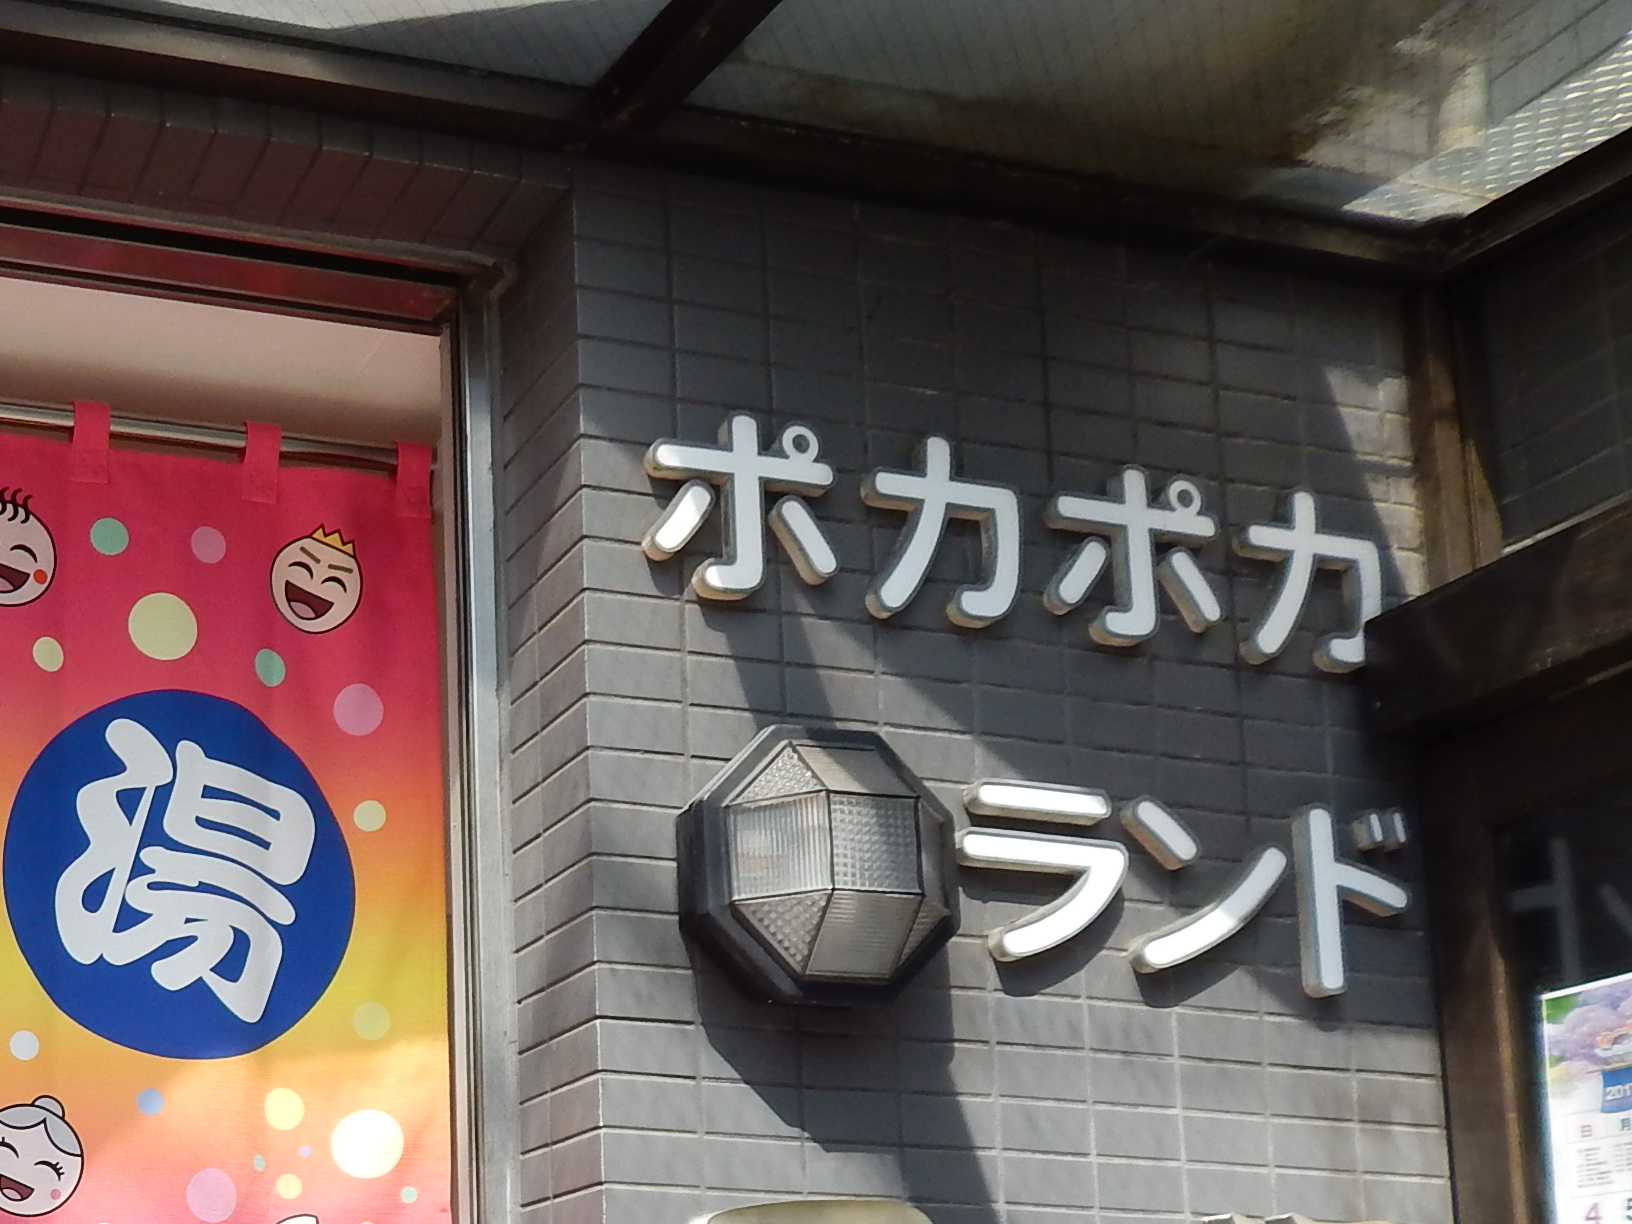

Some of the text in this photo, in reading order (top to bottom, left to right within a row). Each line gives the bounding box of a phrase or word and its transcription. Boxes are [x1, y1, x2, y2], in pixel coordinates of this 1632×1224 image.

[642, 412, 1382, 672] ポカポカ
[956, 779, 1408, 998] ランド
[1605, 1083, 1631, 1101] 201
